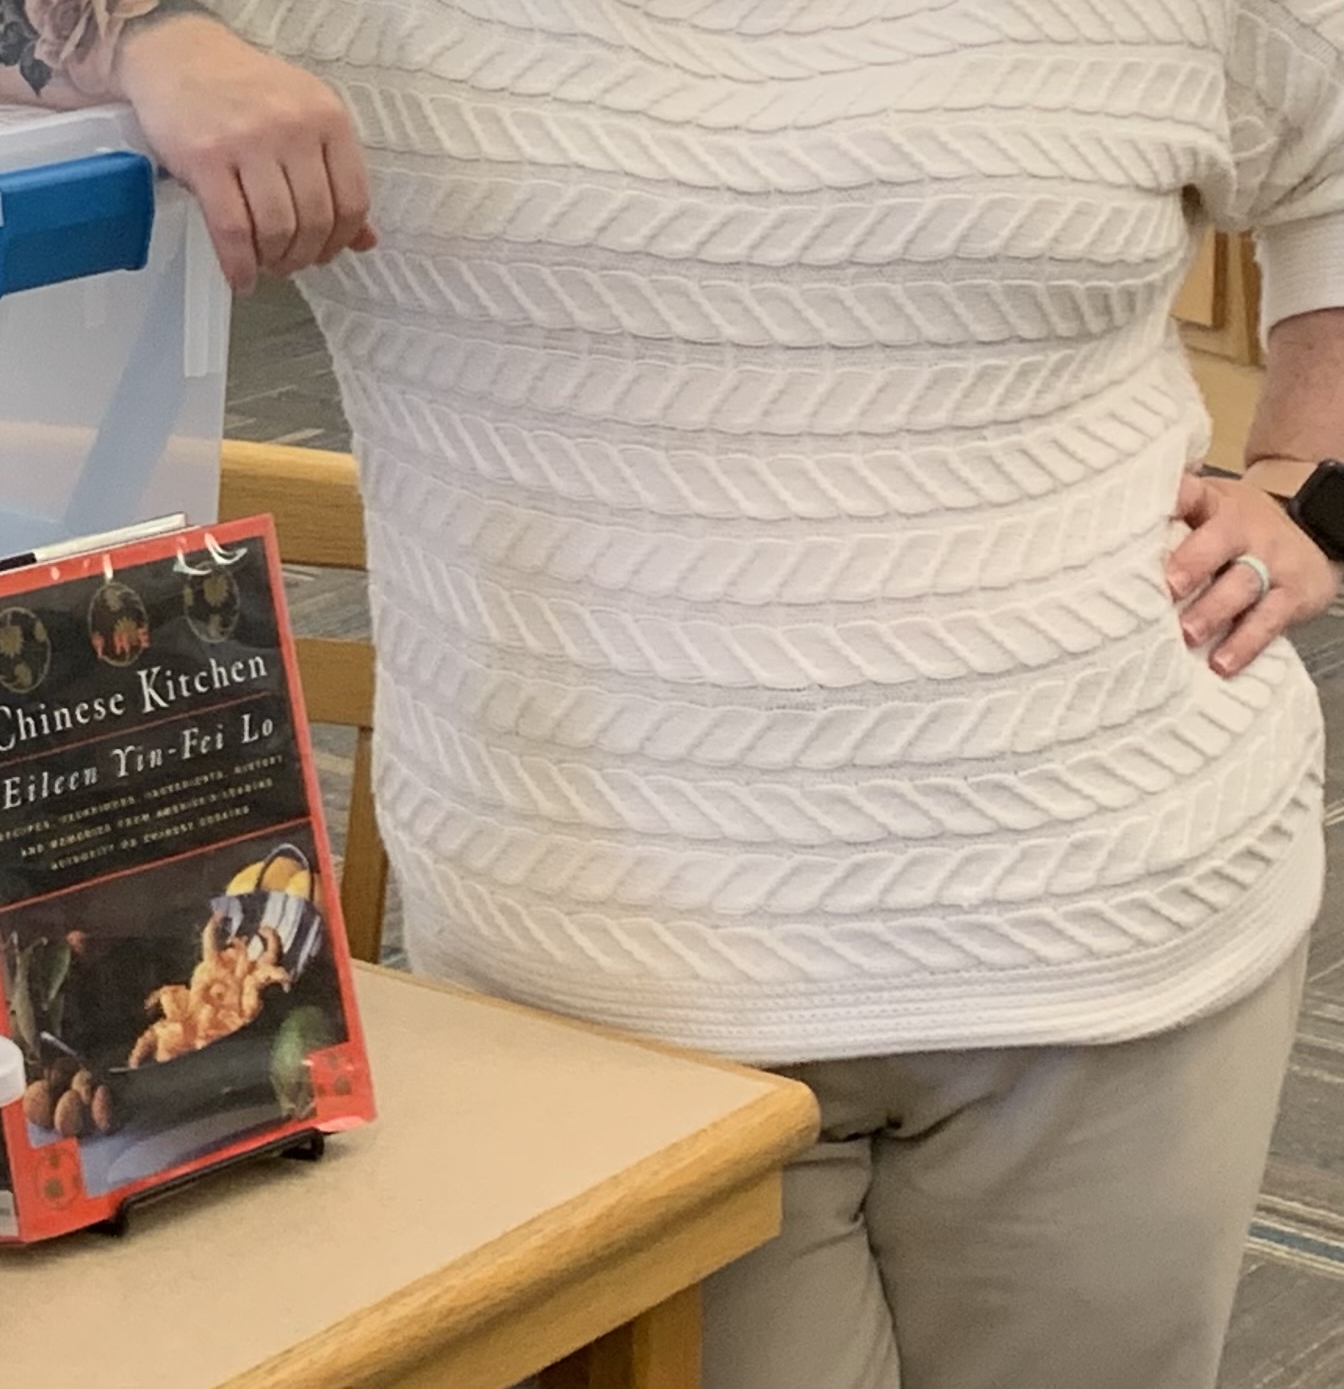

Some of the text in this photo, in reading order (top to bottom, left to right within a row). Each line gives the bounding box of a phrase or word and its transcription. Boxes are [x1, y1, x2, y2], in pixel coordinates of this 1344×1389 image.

[137, 655, 268, 713] Kitchen
[2, 713, 274, 810] Eileen Yin-Fei Lo
